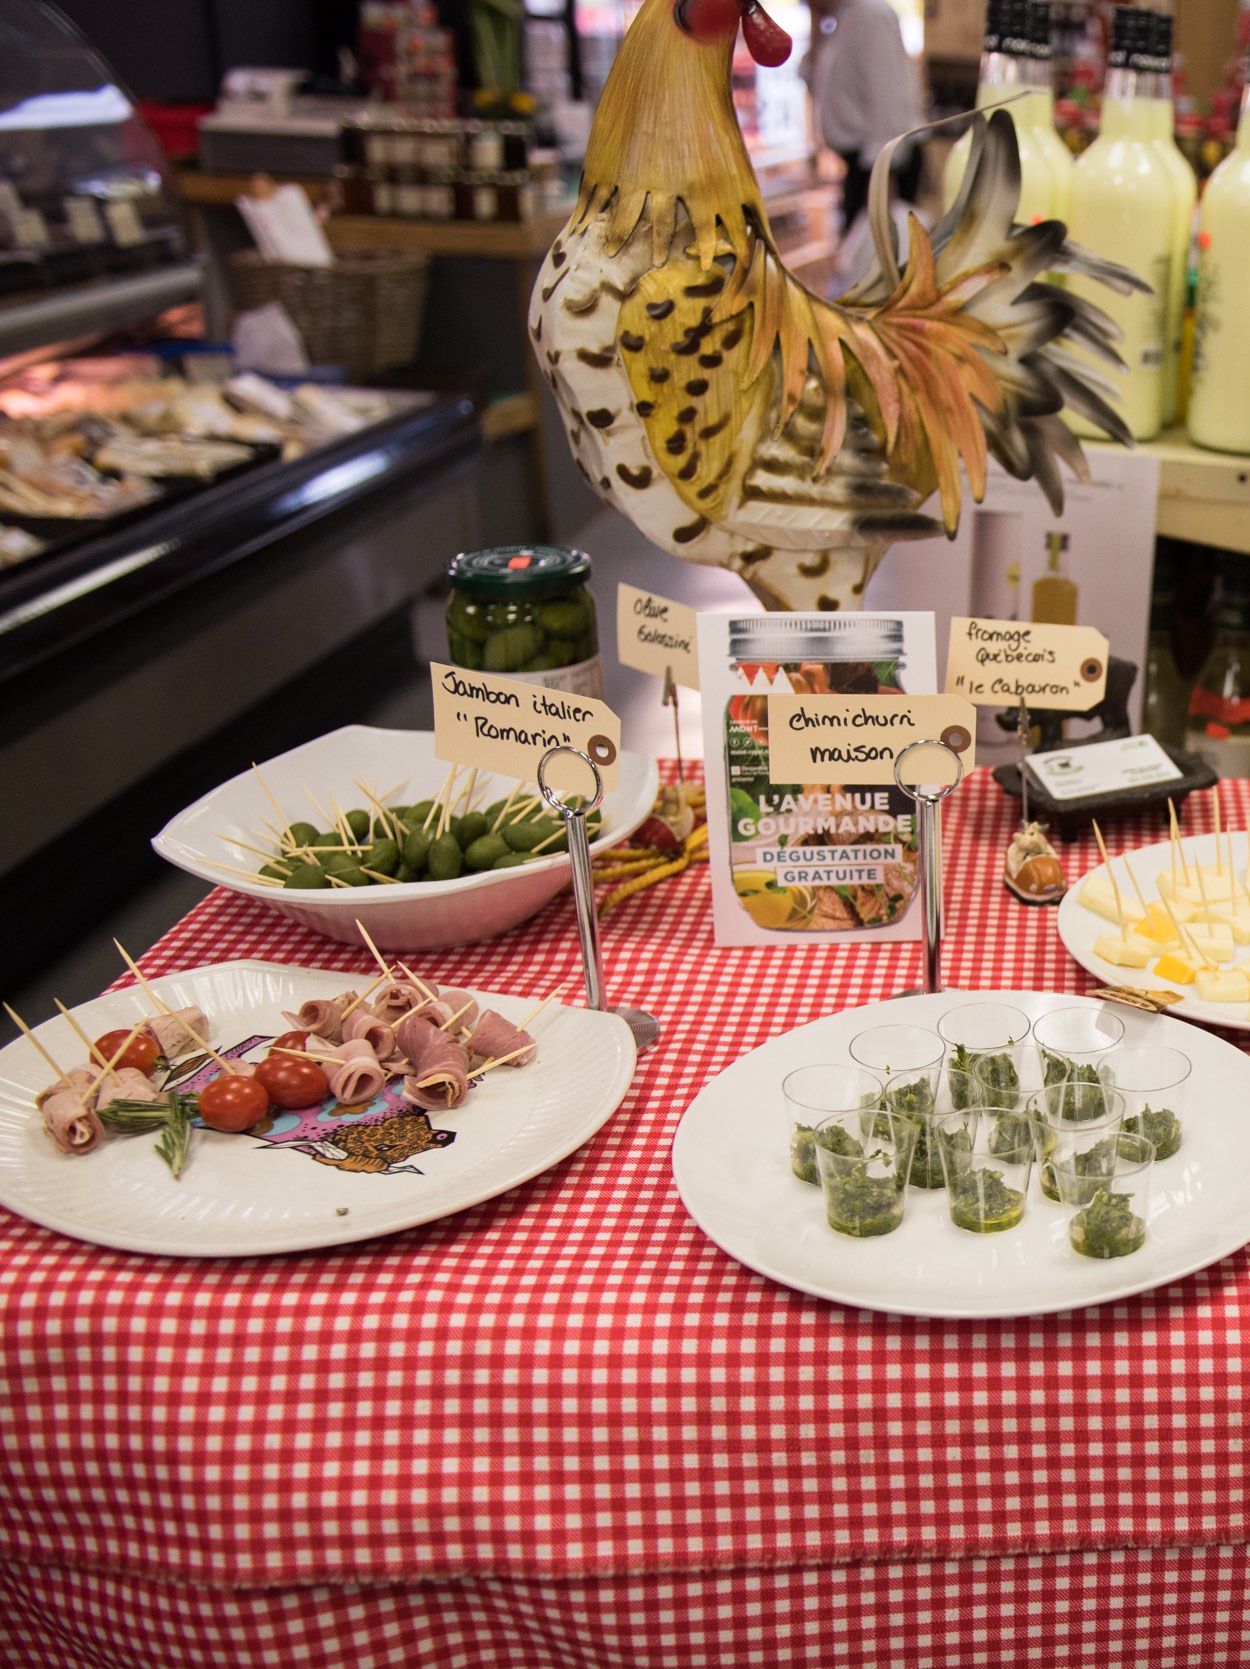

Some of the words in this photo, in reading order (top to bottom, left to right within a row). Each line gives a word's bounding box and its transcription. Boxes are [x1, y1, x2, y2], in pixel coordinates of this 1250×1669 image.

[967, 621, 1032, 651] fromage
[442, 671, 520, 707] Jambon
[810, 743, 894, 764] maison
[759, 792, 890, 813] L'AVENUE
[737, 814, 912, 836] GOURMANDE
[762, 847, 897, 864] DÉGUSTATION
[783, 868, 878, 883] GRATUITE
